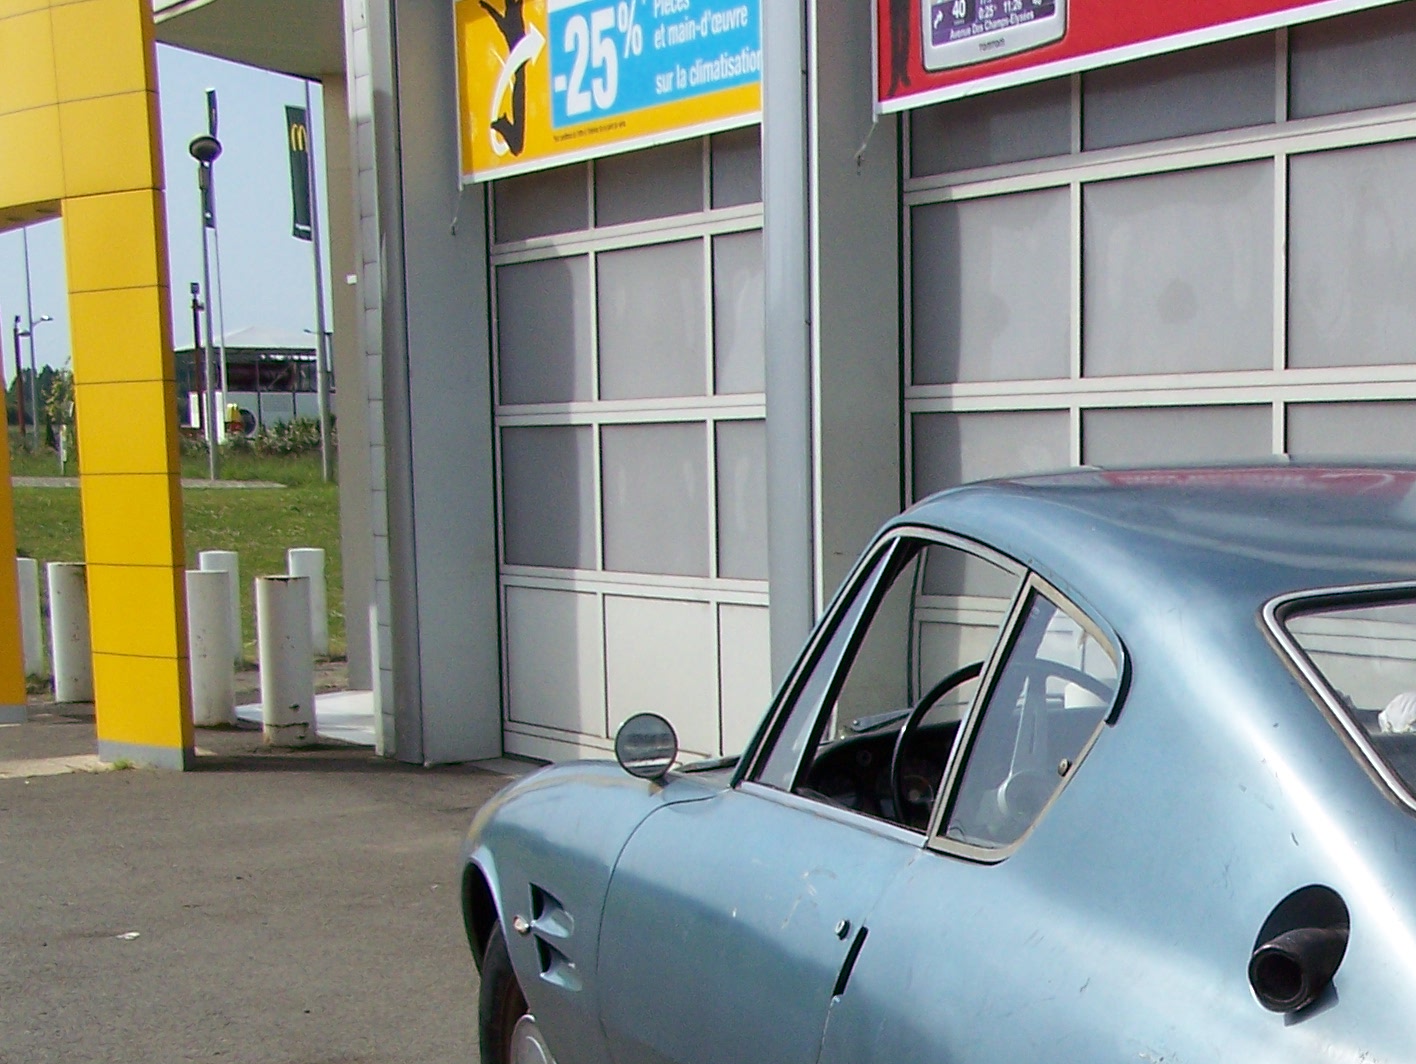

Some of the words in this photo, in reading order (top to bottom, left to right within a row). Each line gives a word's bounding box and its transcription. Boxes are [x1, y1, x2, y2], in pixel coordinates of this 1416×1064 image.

[654, 23, 666, 50] et
[656, 71, 674, 95] sur
[676, 63, 687, 89] la
